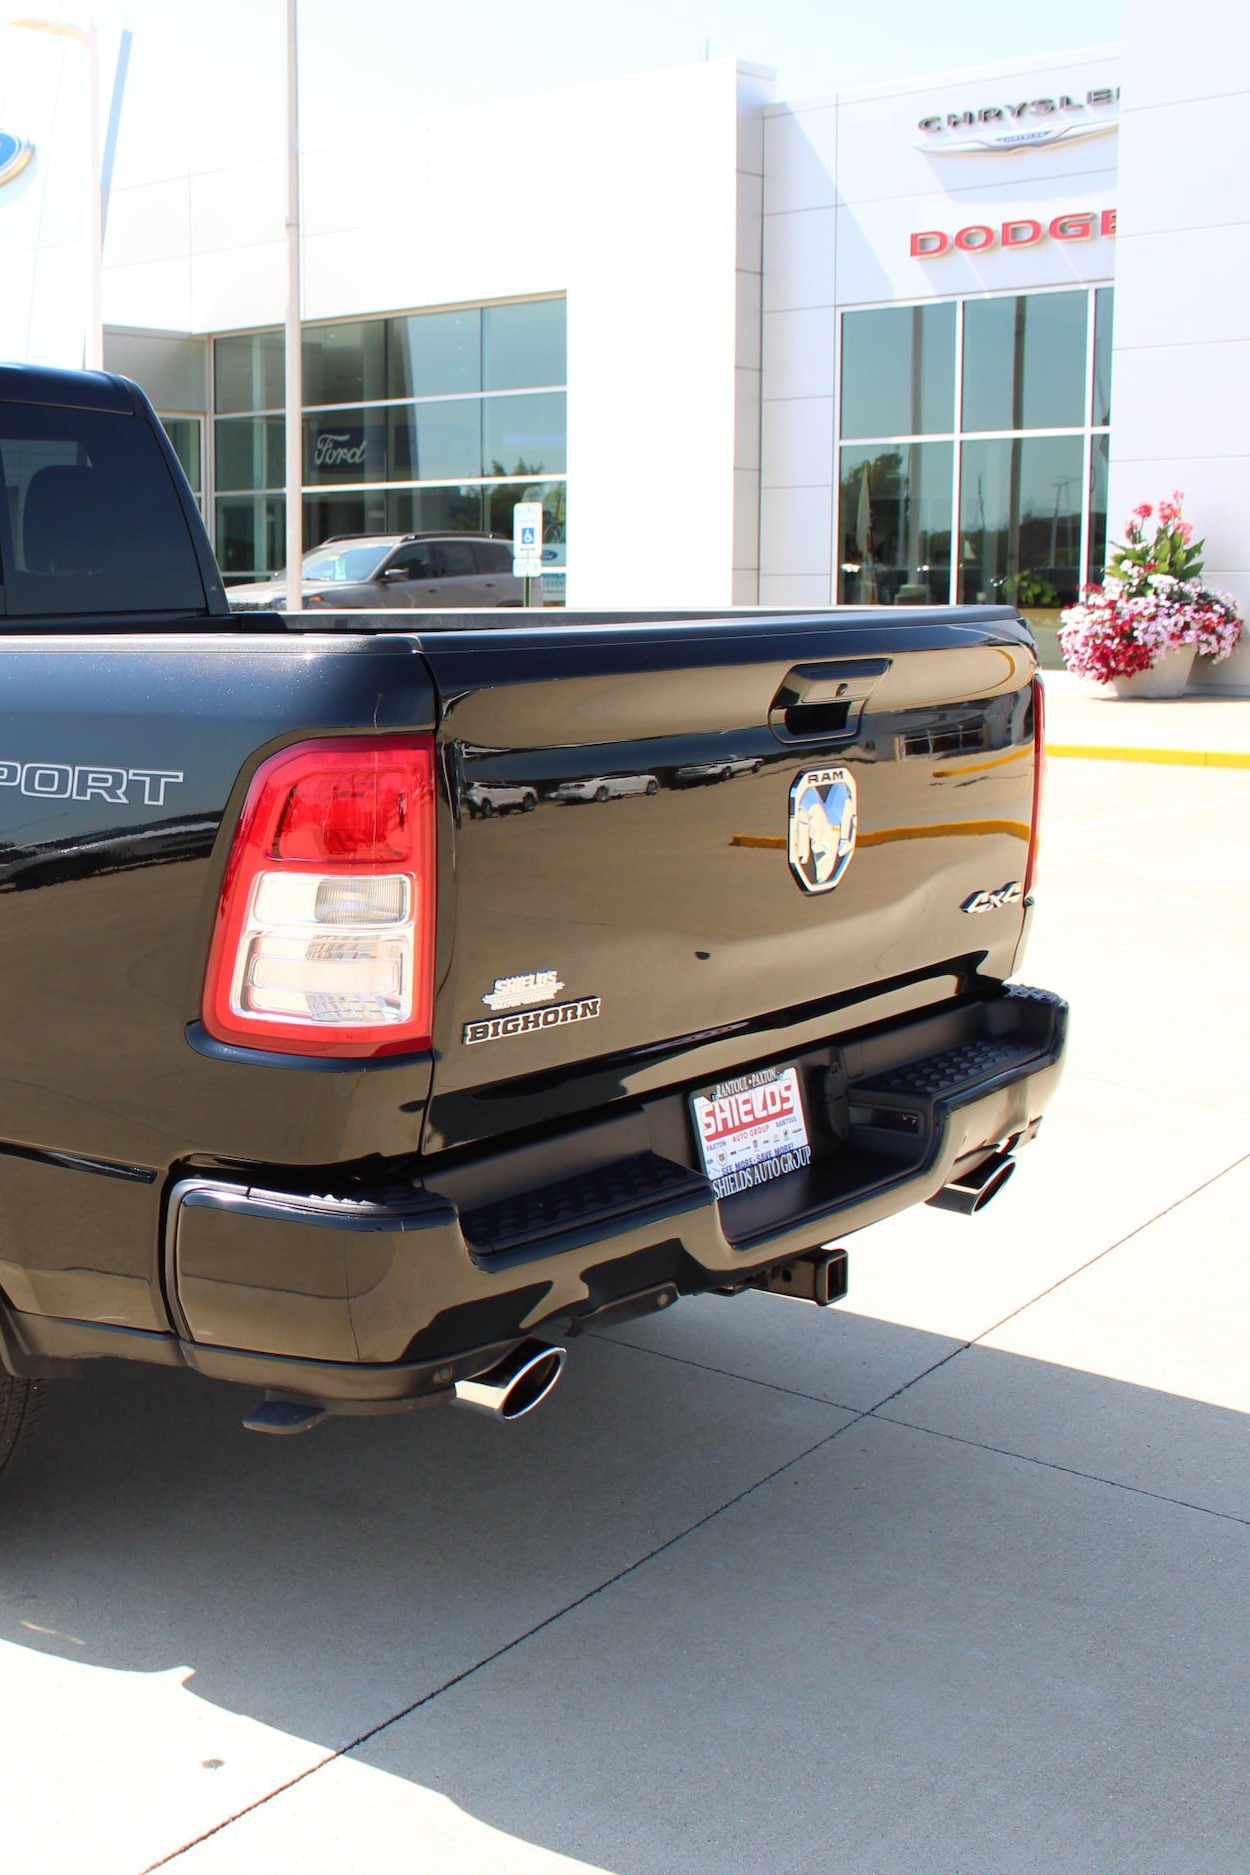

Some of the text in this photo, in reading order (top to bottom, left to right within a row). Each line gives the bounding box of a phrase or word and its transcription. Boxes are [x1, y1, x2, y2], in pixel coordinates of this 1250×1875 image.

[918, 86, 1120, 133] CHRYSLE
[314, 433, 367, 466] Ford
[807, 770, 845, 784] RAM
[465, 997, 601, 1045] BIGHORN
[715, 1068, 777, 1098] RANTOUL PAXTON
[700, 1078, 795, 1137] SHIELDS
[732, 1124, 770, 1143] AUTO GROUP
[712, 1145, 812, 1200] SHIELDS AUTO GROUP
